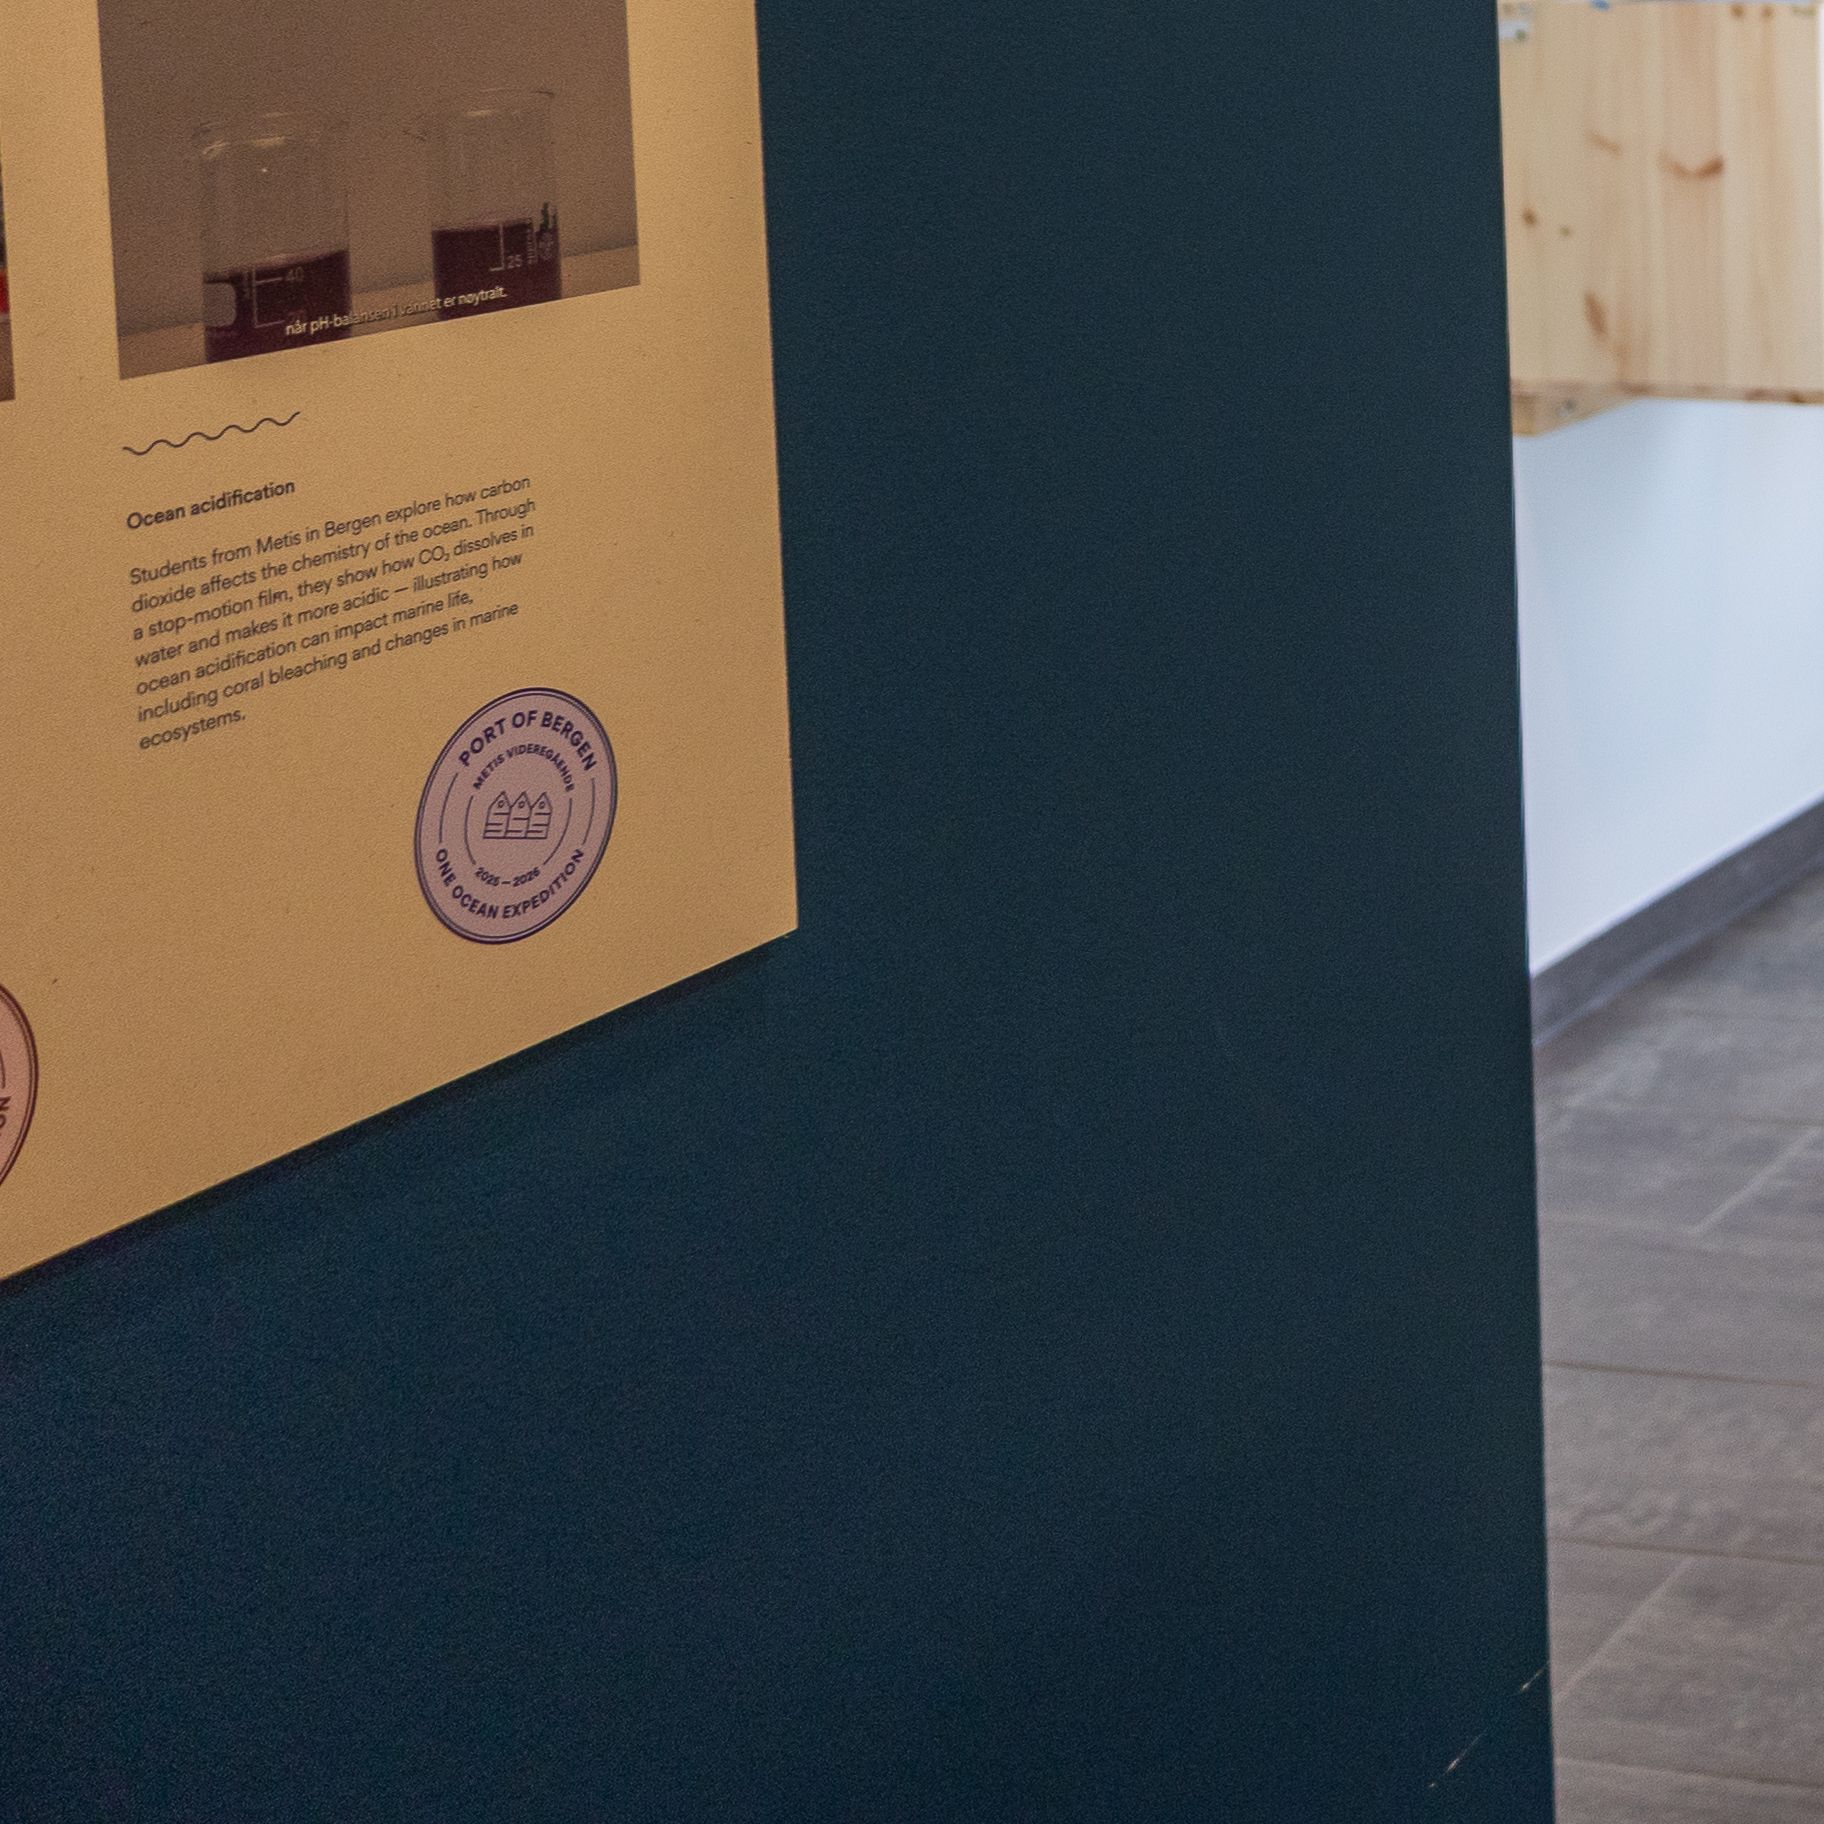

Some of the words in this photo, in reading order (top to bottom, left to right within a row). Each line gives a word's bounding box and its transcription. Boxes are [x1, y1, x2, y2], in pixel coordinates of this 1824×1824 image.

[285, 319, 307, 336] når
[310, 308, 391, 335] pH-balansen
[443, 296, 457, 308] er
[126, 506, 186, 529] Ocean
[190, 481, 296, 516] acidification
[130, 555, 208, 585] Students
[212, 545, 251, 566] from
[256, 531, 301, 554] Metis
[305, 527, 320, 543] in
[324, 513, 382, 538] Bergen
[385, 499, 441, 523] explore
[445, 490, 477, 508] how
[480, 477, 531, 500] carbon
[131, 585, 196, 613] dioxide
[200, 570, 257, 596] affects
[261, 562, 288, 580] the
[292, 541, 372, 572] chemistry
[375, 531, 391, 551] of
[394, 529, 419, 546] the
[422, 518, 473, 539] ocean.
[476, 498, 536, 525] Through
[133, 627, 143, 640] a
[148, 599, 253, 637] stop-motion
[258, 588, 293, 607] film,
[298, 577, 333, 597] they
[336, 565, 378, 587] show
[381, 557, 415, 575] how
[453, 528, 518, 556] dissolves
[521, 524, 534, 539] in
[135, 644, 184, 667] water
[188, 629, 220, 653] and
[225, 618, 278, 643] makes
[282, 612, 293, 627] it
[298, 602, 339, 624] more
[343, 588, 390, 609] acidic
[413, 561, 488, 592] illustrating
[492, 552, 523, 571] how
[136, 669, 191, 695] ocean
[195, 640, 297, 678] acidification
[300, 630, 330, 649] can
[335, 614, 388, 640] impact
[392, 600, 444, 624] marine
[447, 590, 474, 608] life,
[138, 689, 218, 722] including
[223, 671, 264, 698] coral
[268, 651, 348, 685] bleaching
[352, 639, 381, 661] and
[385, 623, 449, 652] changes
[452, 617, 466, 632] in
[470, 603, 519, 626] marine
[139, 709, 246, 749] ecosystems.
[458, 717, 508, 767] PORT
[511, 709, 538, 729] OF
[540, 711, 598, 772] BERGEN
[473, 753, 506, 790] METIS
[436, 848, 454, 887] ONE
[452, 884, 498, 919] OCEAN
[502, 848, 585, 919] EXPEDITION
